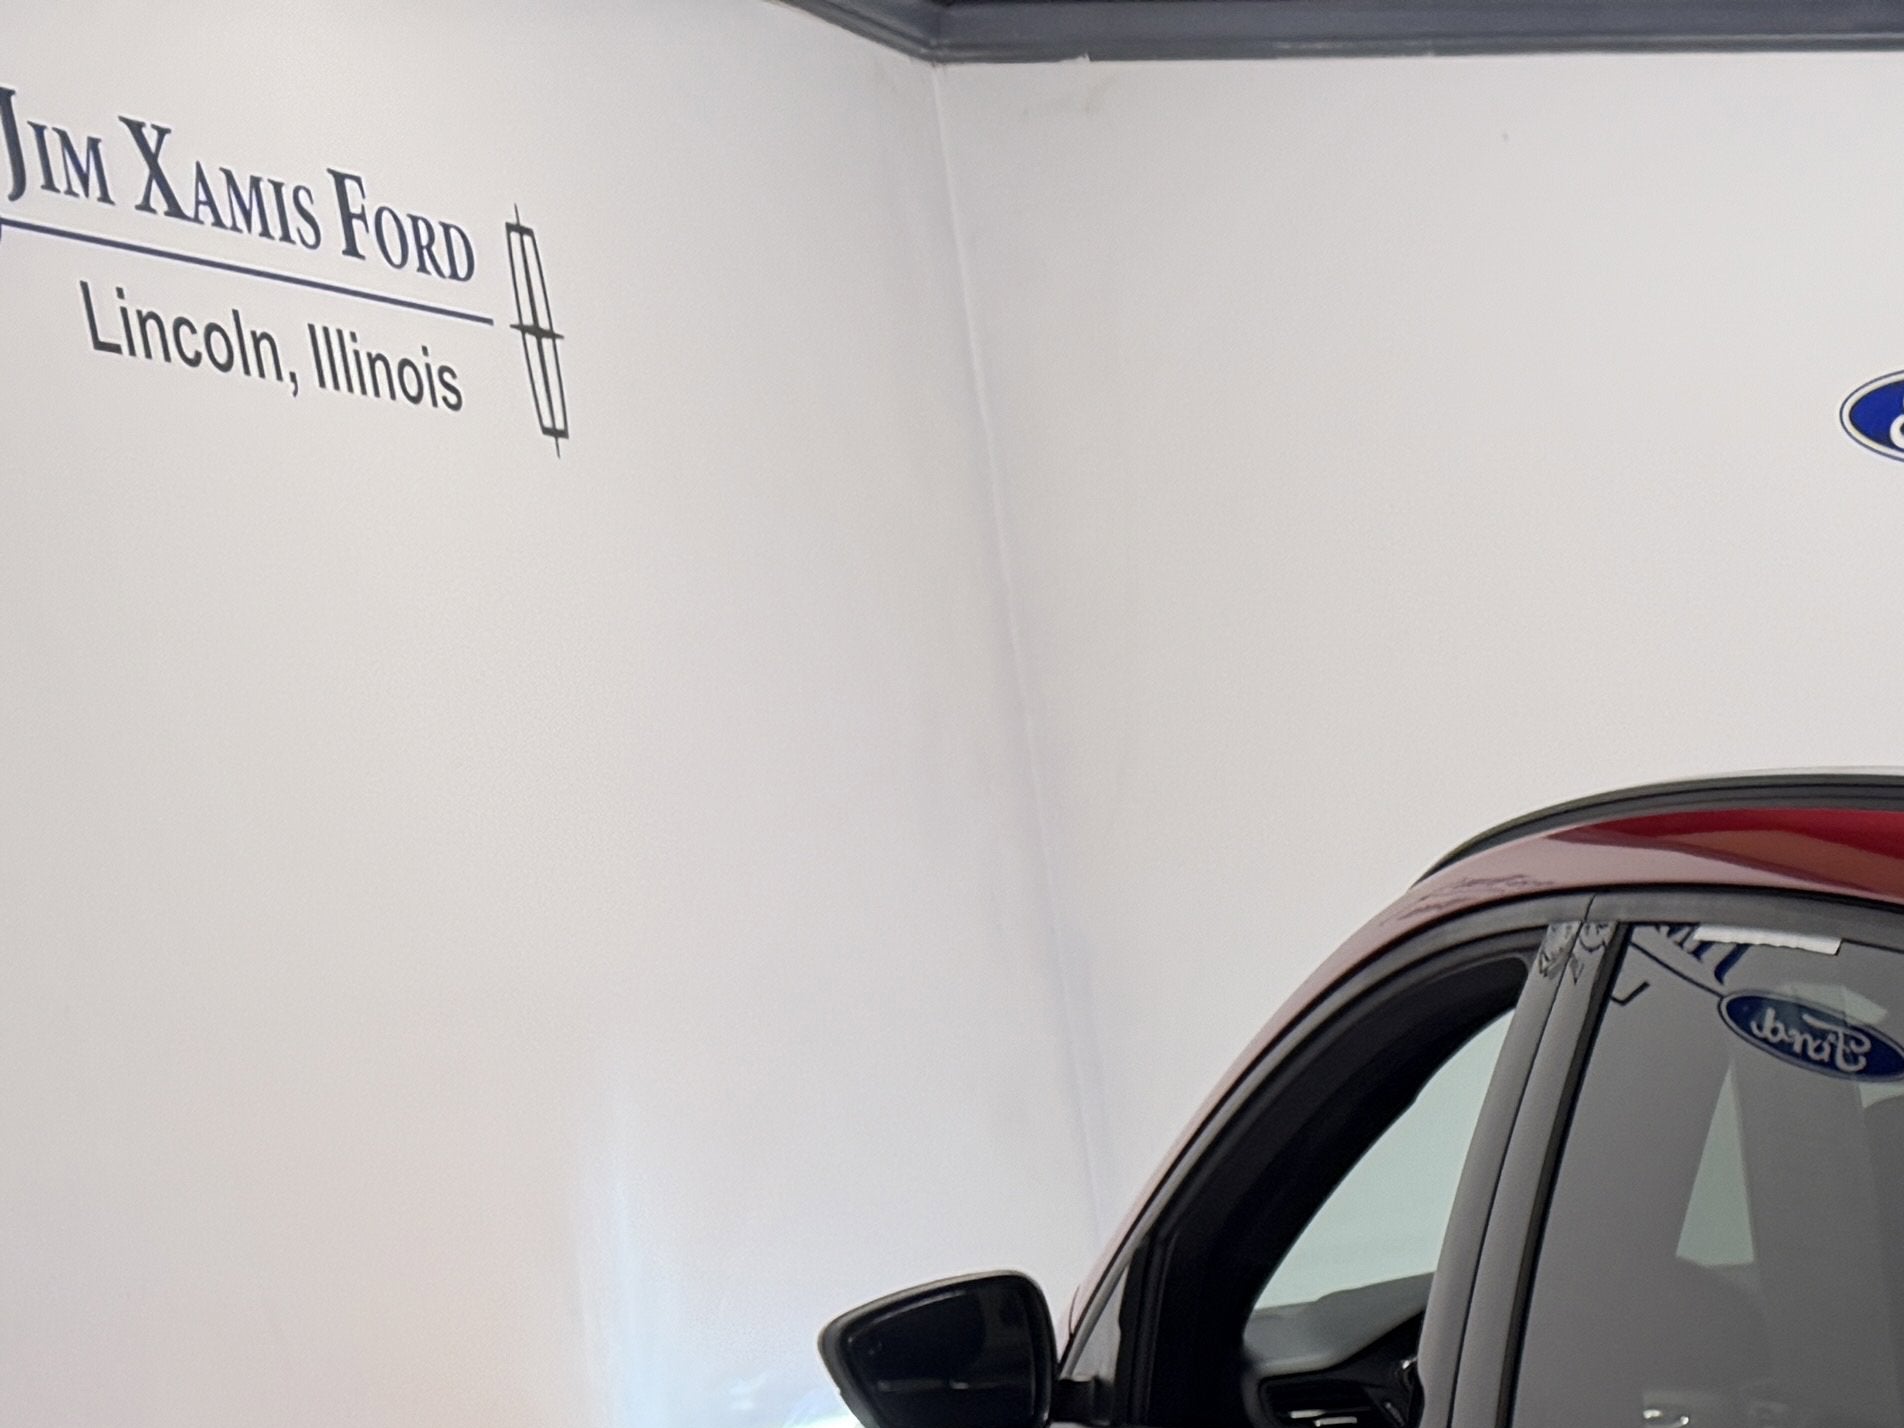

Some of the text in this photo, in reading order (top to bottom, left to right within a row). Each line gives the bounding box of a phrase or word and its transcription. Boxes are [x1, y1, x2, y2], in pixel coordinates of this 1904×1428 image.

[118, 115, 322, 250] XAMIS
[326, 167, 476, 283] FORD
[79, 280, 464, 413] Lincoln, Illinois
